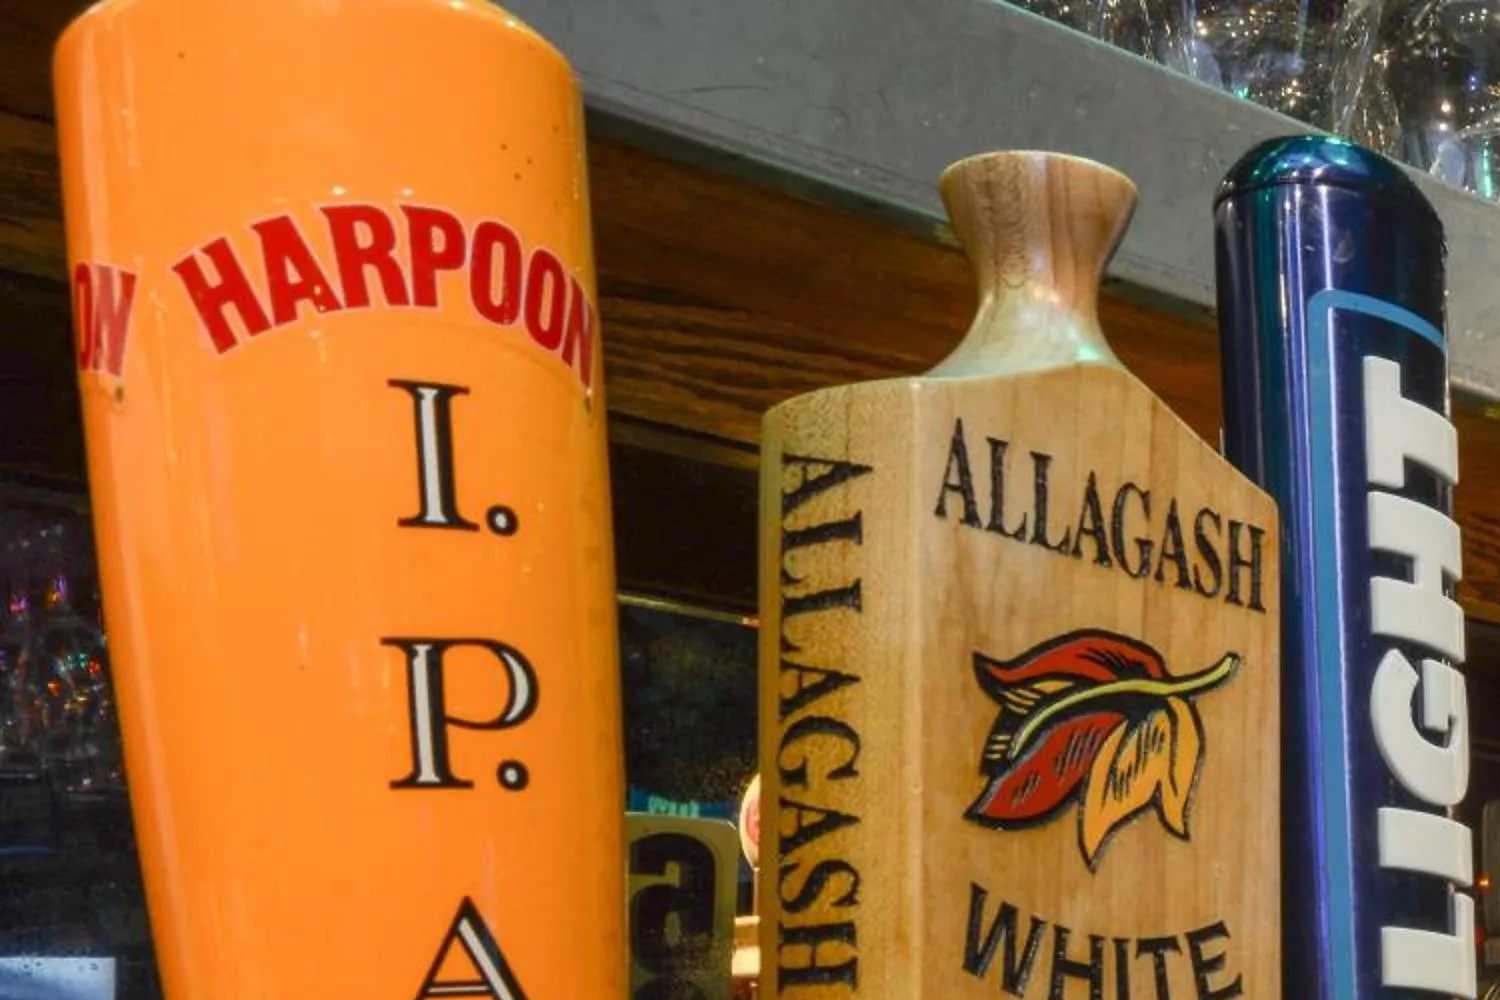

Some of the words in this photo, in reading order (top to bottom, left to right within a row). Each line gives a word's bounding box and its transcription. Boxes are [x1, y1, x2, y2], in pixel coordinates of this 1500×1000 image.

[172, 204, 594, 387] HARPOON
[934, 417, 1267, 613] ALLAGASH
[1363, 355, 1477, 999] LIGHT
[776, 451, 873, 992] ALLAGASH
